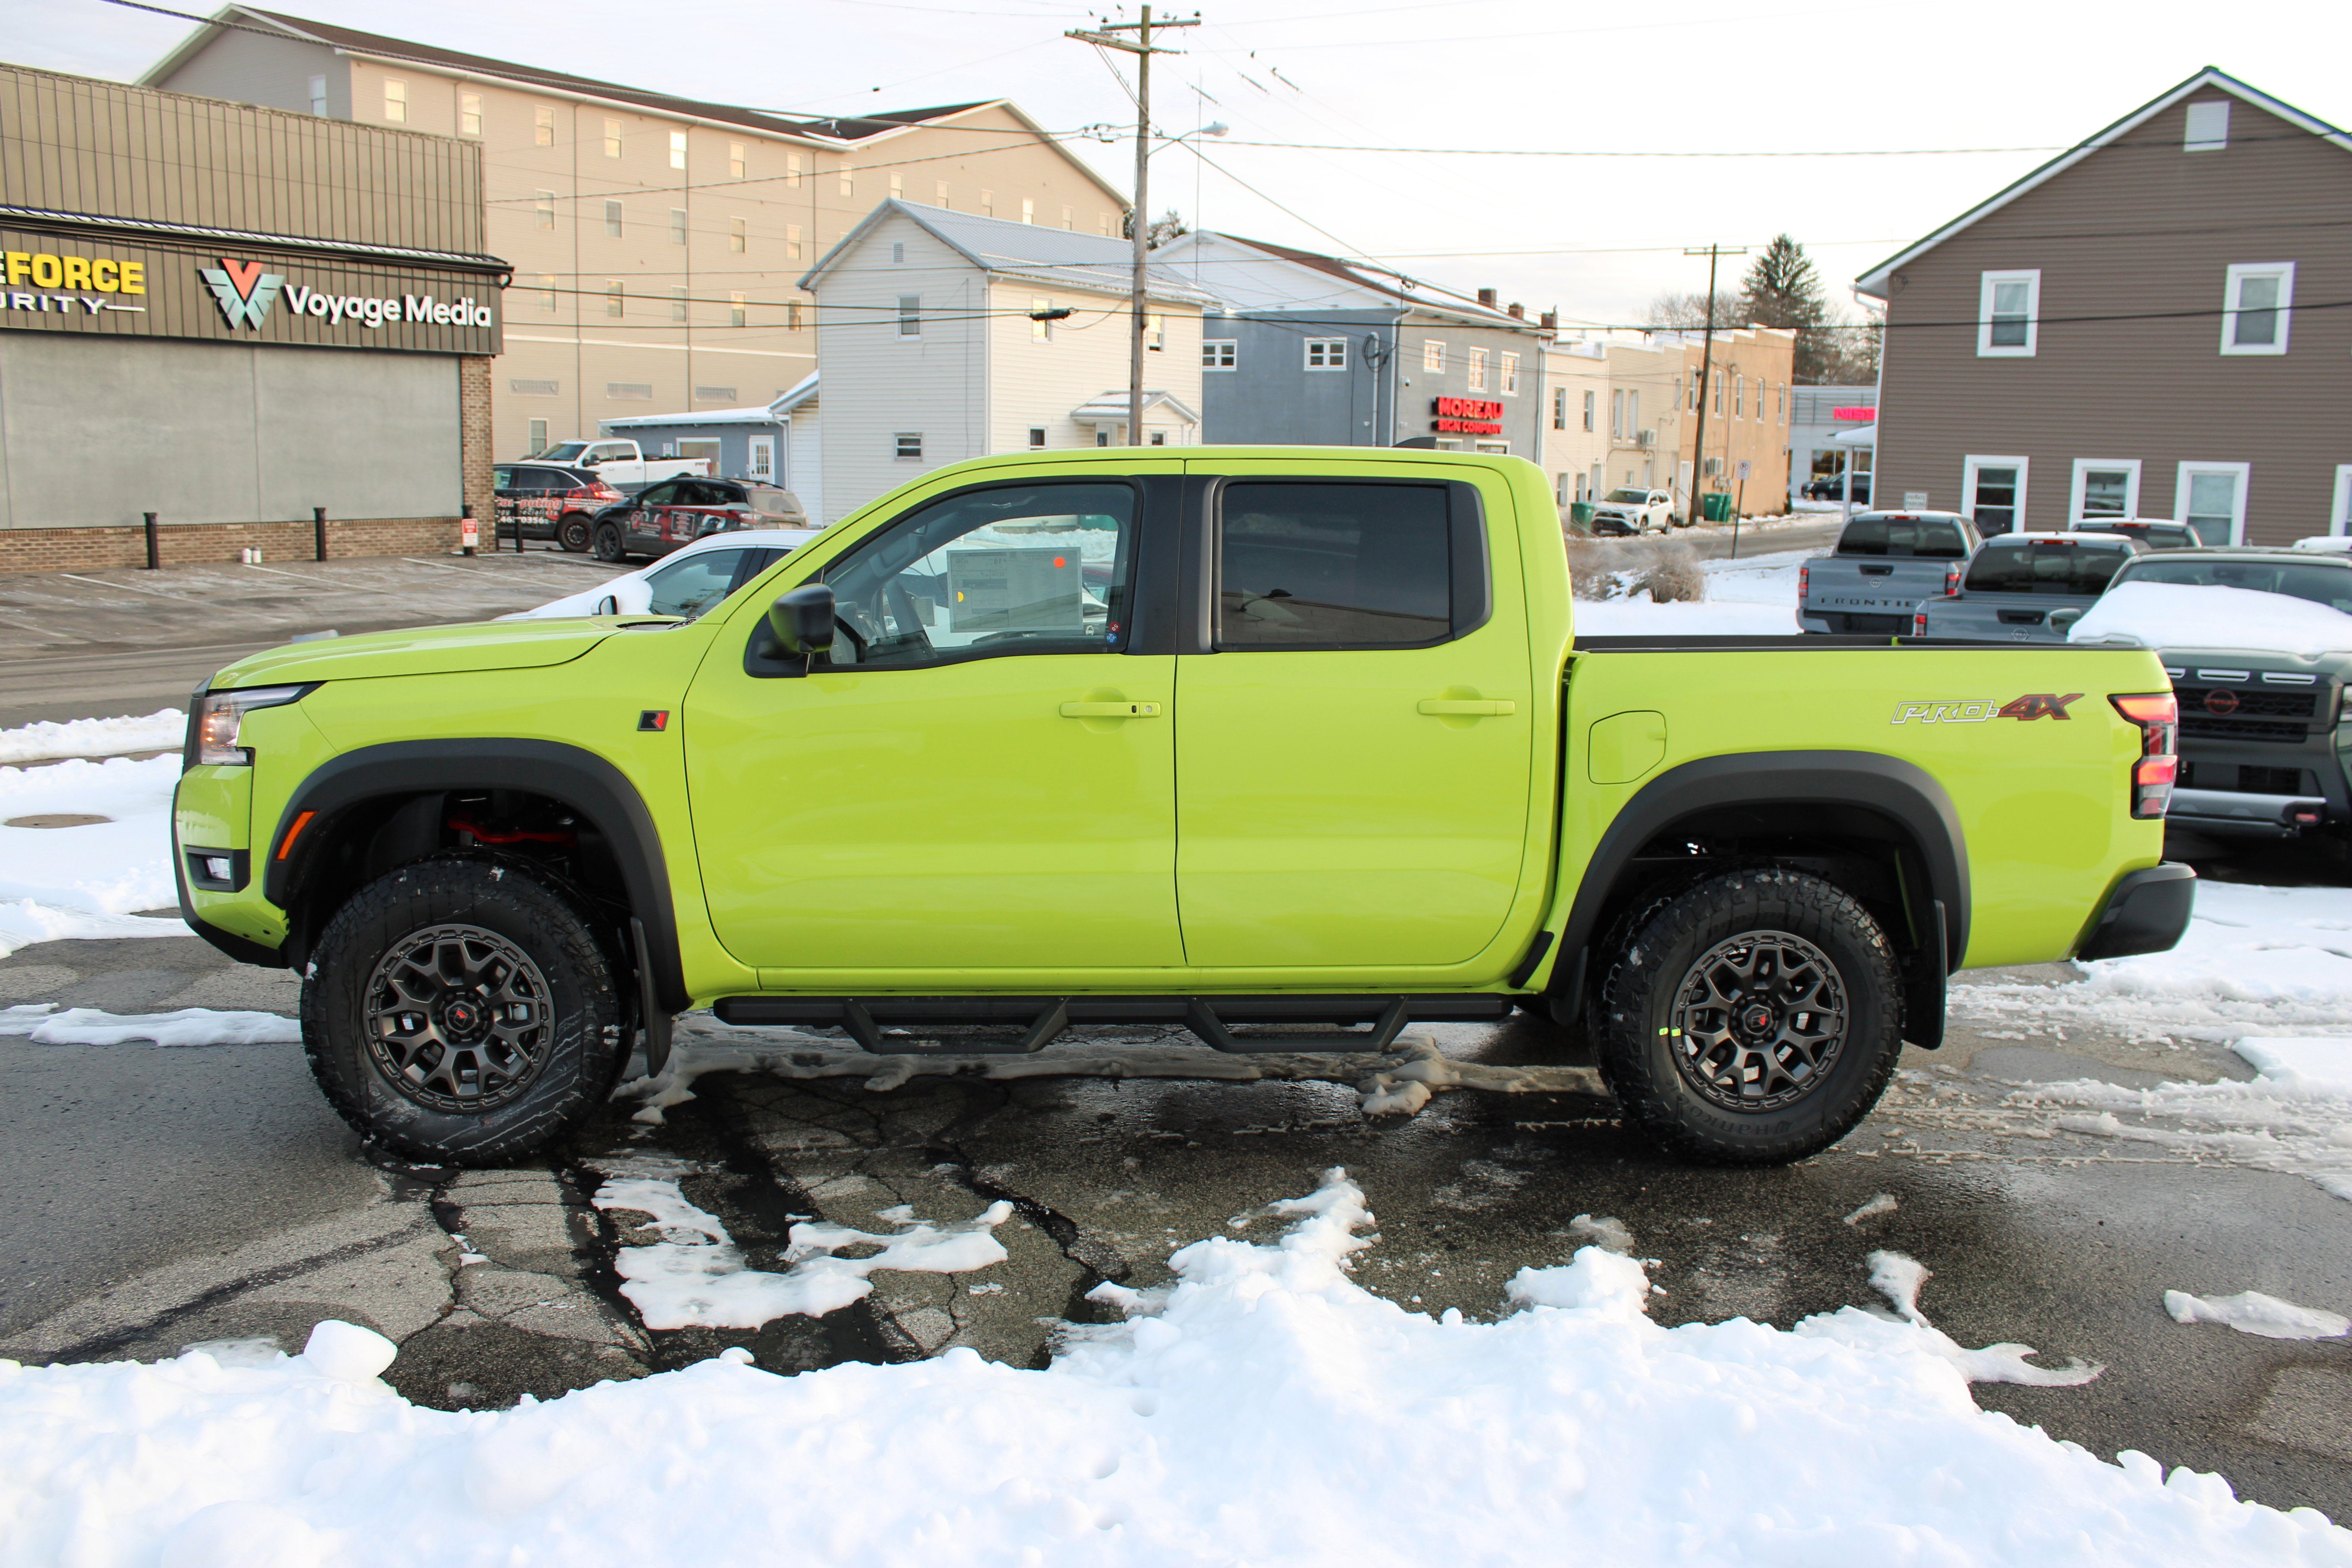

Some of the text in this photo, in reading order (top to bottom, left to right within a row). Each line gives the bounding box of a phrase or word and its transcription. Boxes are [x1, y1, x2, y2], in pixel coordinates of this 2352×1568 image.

[0, 251, 145, 294] FORCE
[285, 283, 492, 327] Voyage Media
[1439, 396, 1504, 419] MOREAU
[1833, 406, 1877, 421] NISS
[1821, 597, 1917, 607] FRONTIE
